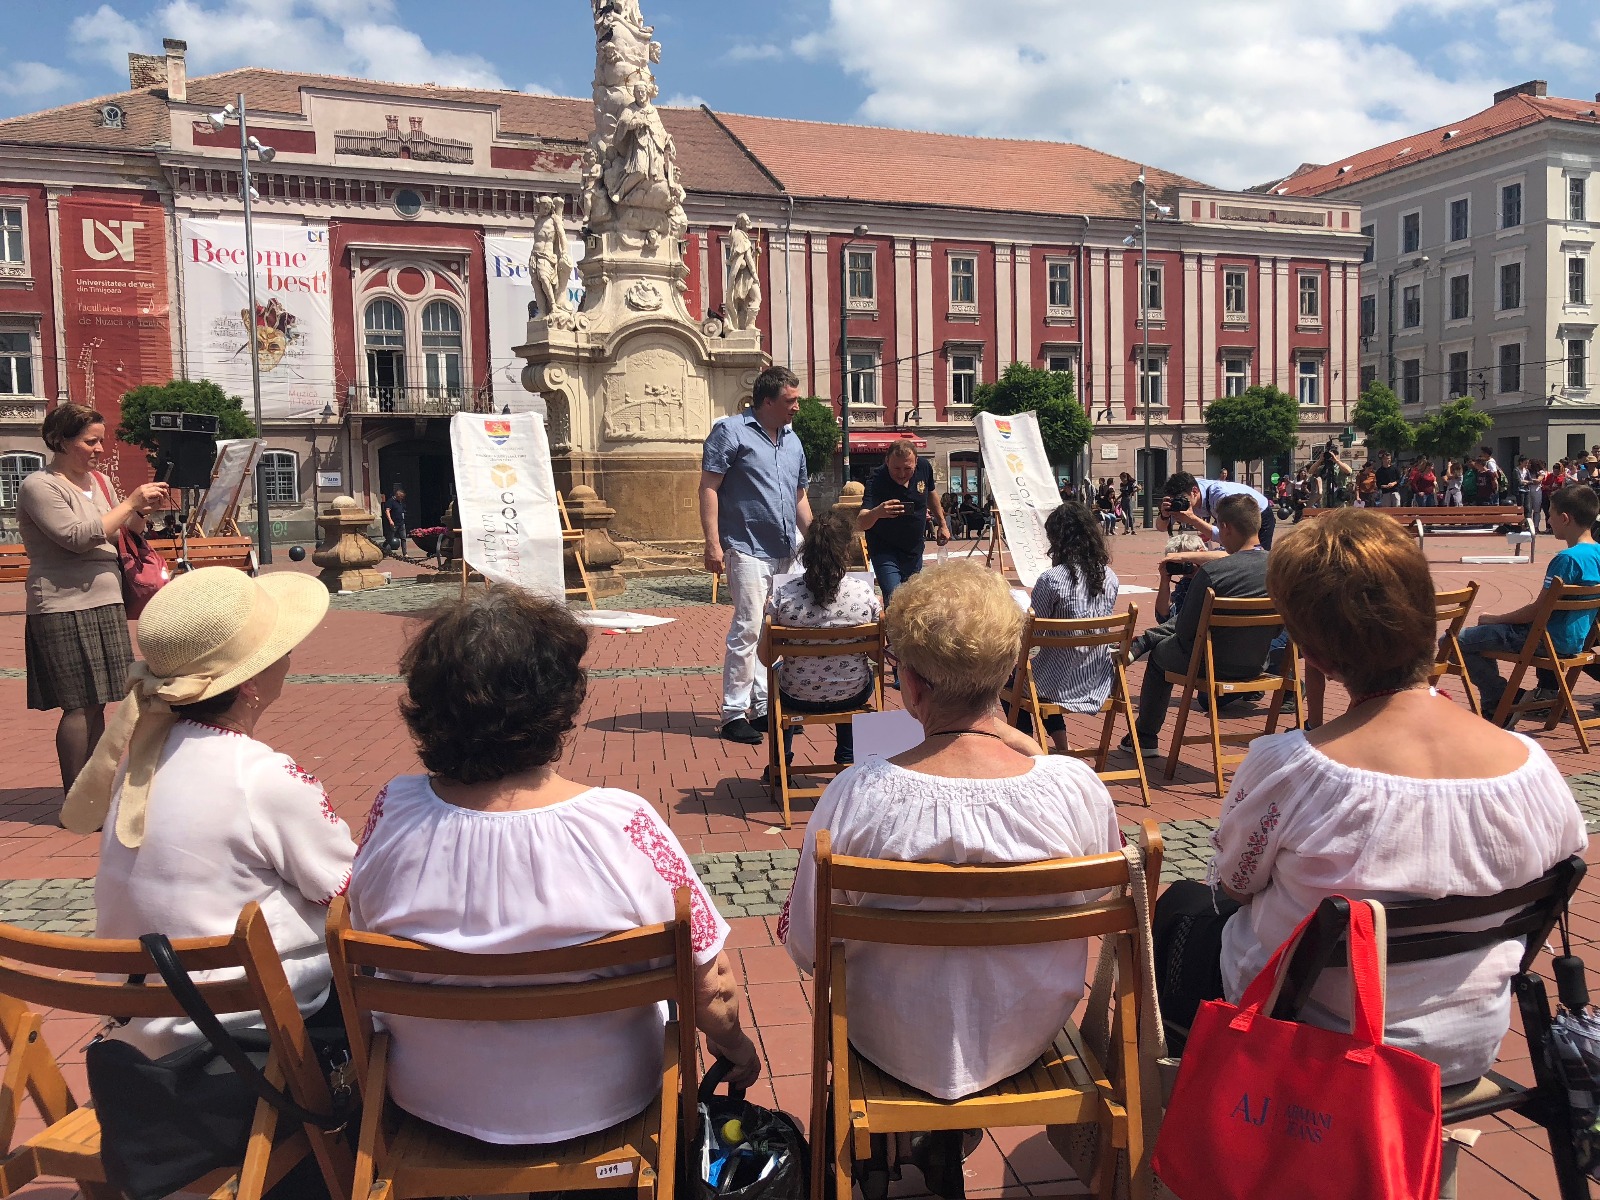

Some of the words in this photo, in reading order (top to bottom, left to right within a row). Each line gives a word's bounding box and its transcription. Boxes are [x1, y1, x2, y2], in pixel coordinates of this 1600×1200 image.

[187, 238, 306, 268] Become
[234, 270, 261, 280] yor
[267, 267, 327, 294] best!
[76, 278, 127, 287] Universitatea
[128, 279, 138, 288] de
[138, 280, 156, 289] Vest
[78, 317, 92, 325] de
